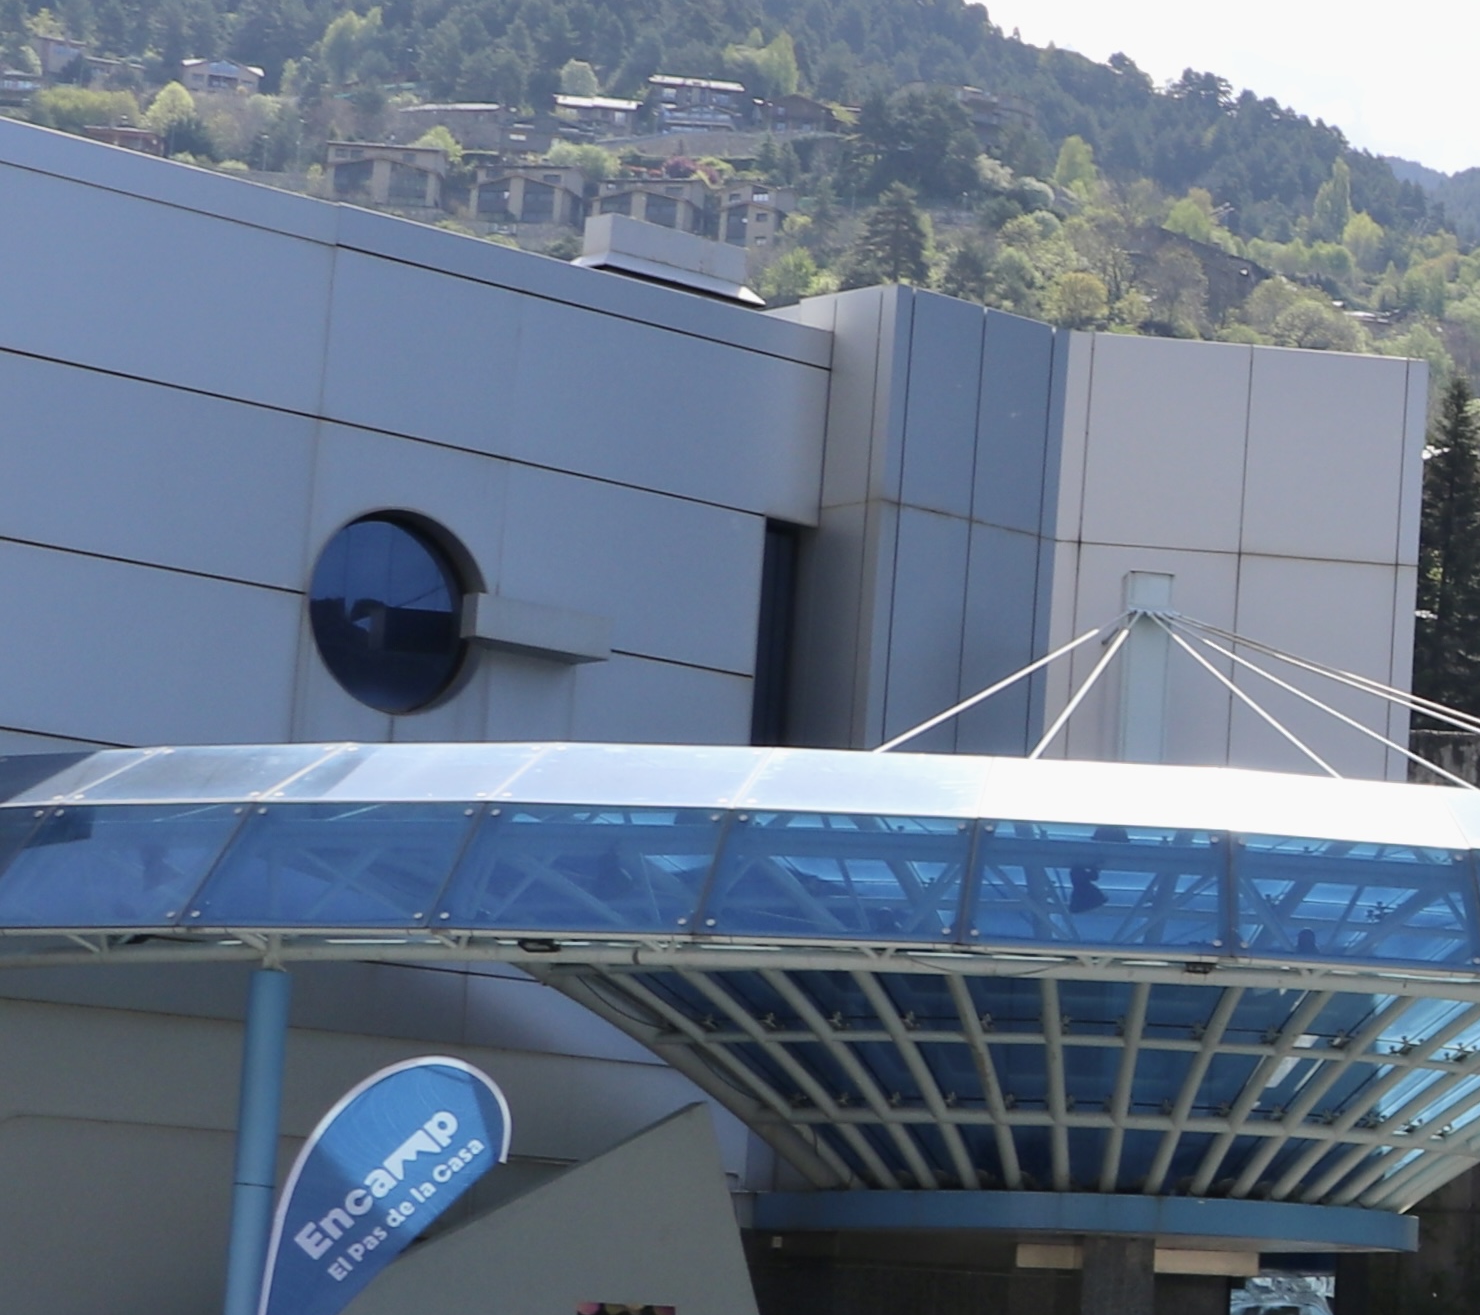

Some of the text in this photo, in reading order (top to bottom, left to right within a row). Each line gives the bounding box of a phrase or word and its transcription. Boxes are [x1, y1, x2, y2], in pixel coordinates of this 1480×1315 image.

[294, 1111, 458, 1260] Encamp
[327, 1139, 485, 1281] El Pas de la Casa
